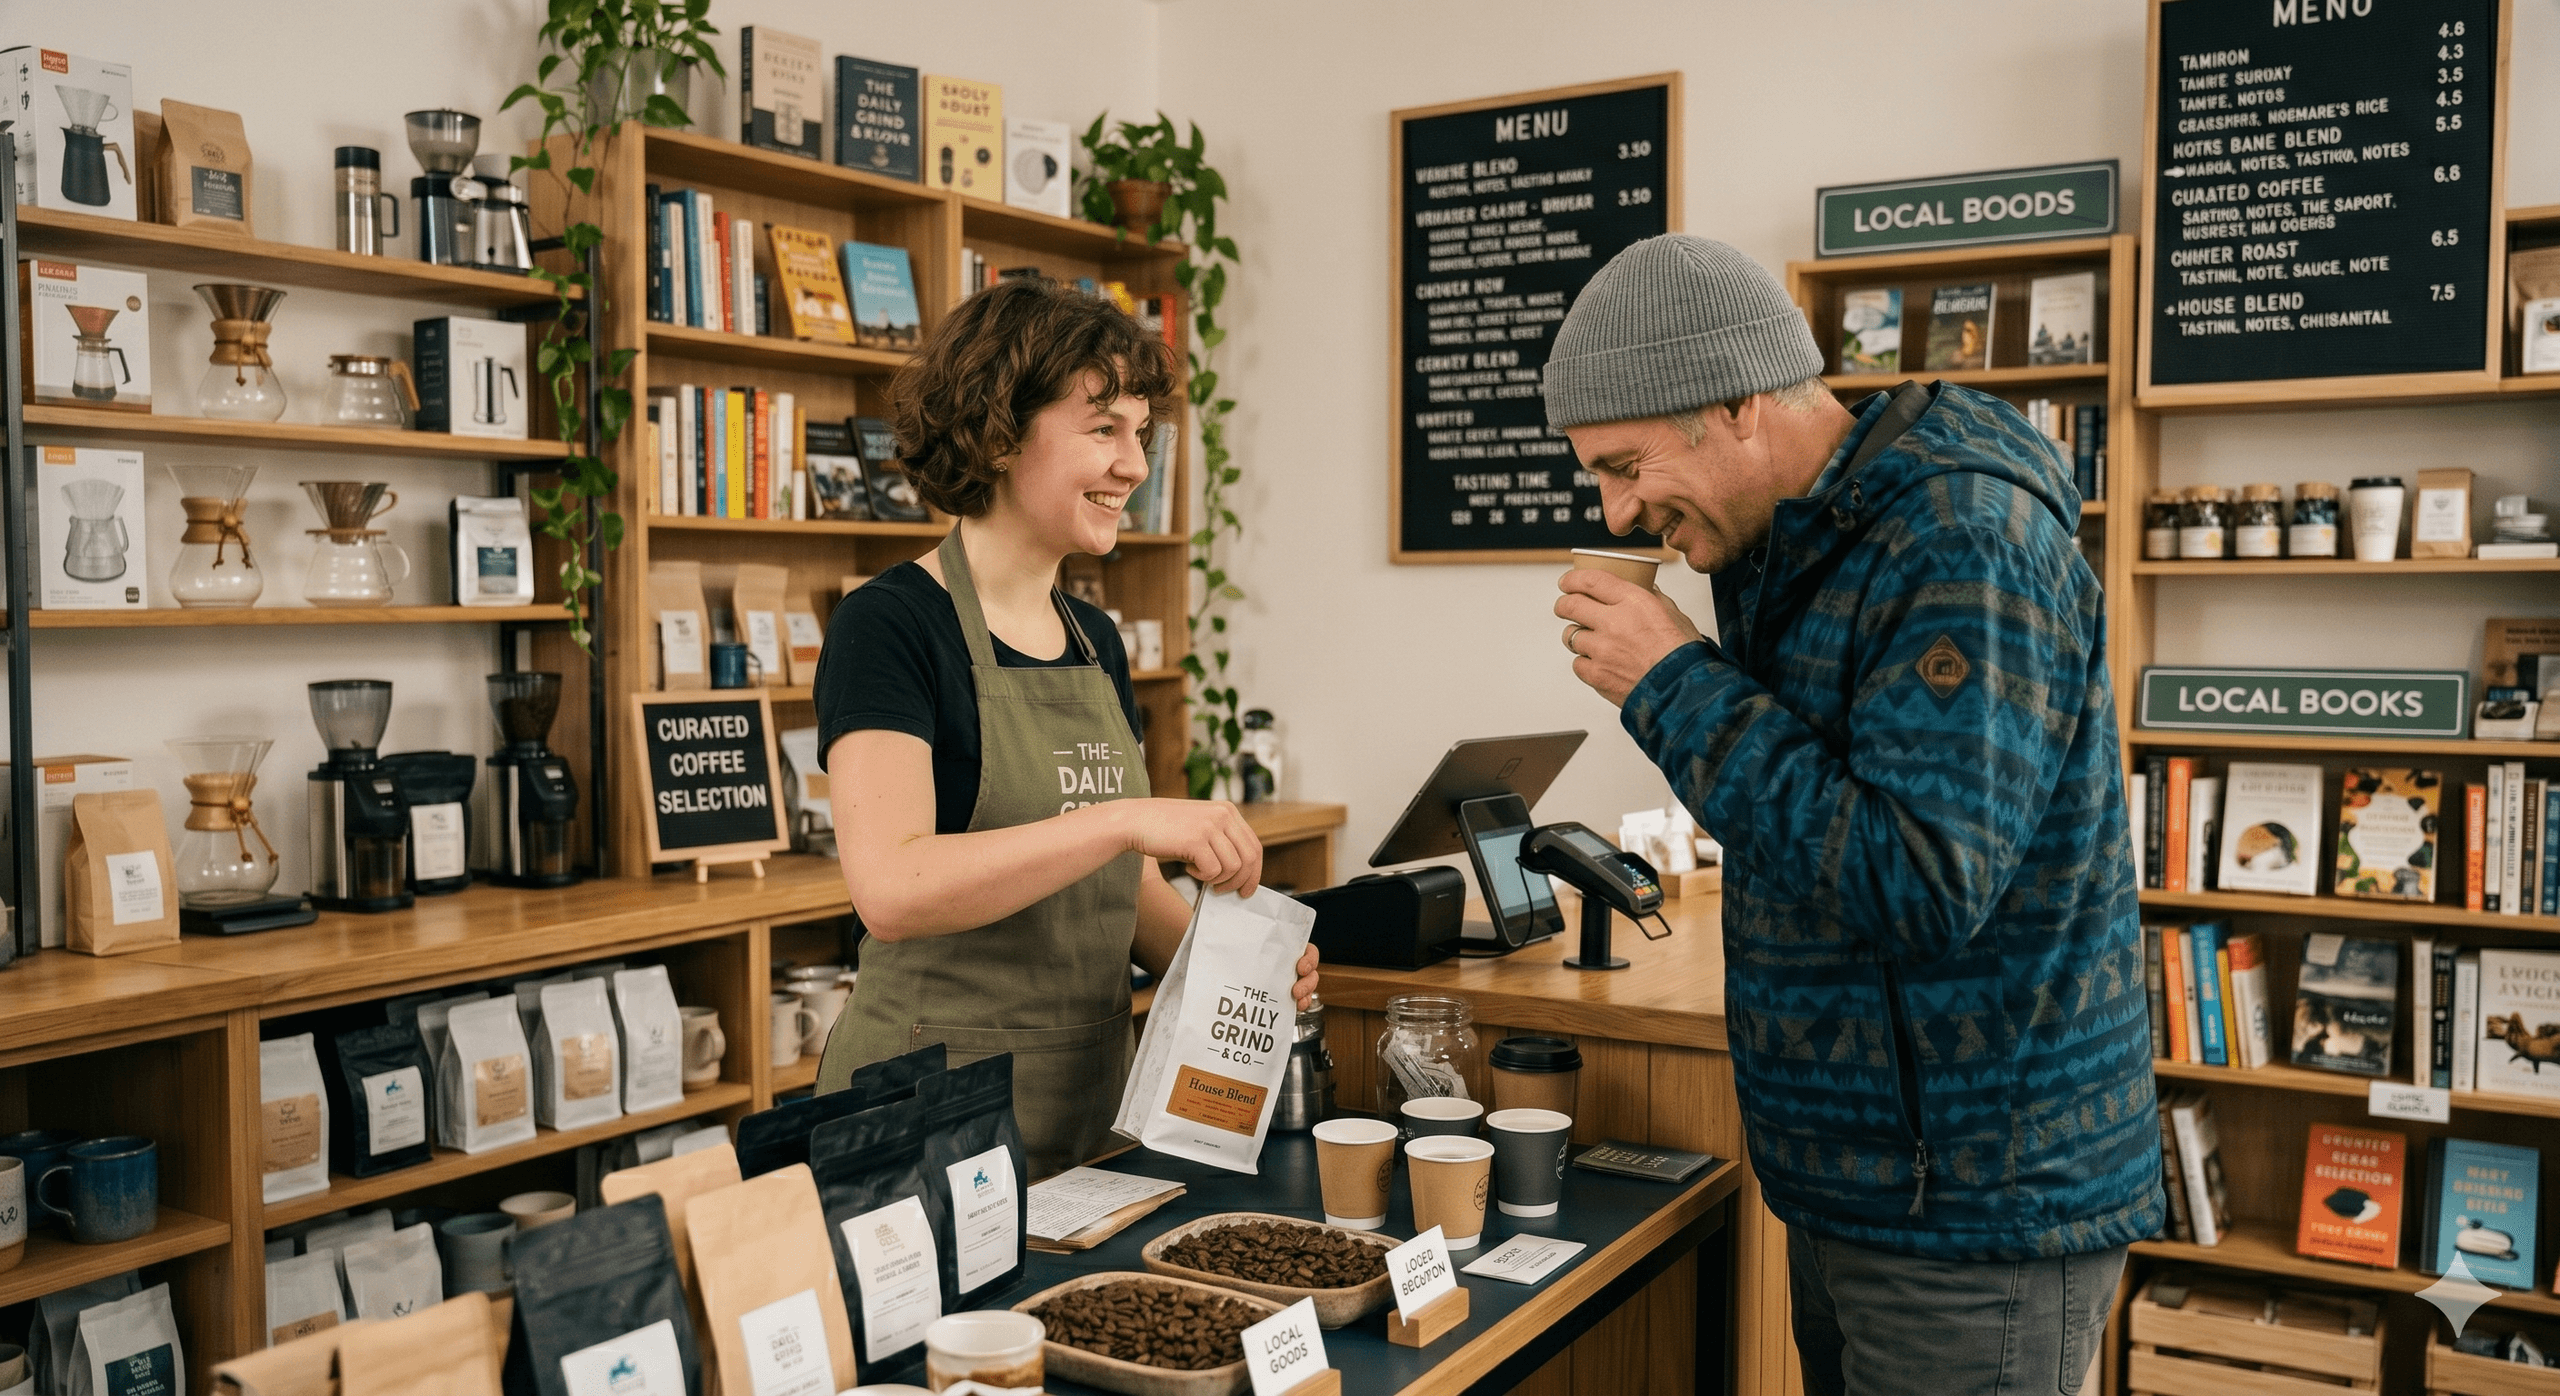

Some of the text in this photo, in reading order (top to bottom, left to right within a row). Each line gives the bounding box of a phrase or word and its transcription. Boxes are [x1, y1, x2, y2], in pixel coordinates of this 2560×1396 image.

[2437, 43, 2464, 61] 4.3
[2437, 66, 2464, 84] 3.5
[865, 78, 895, 97] THE
[2435, 89, 2463, 108] 4.5
[857, 93, 903, 112] DAILY
[2355, 97, 2389, 115] RICE
[1495, 108, 1568, 143] MENU
[2435, 114, 2462, 133] 5.5
[2230, 132, 2277, 154] BANE
[2284, 126, 2342, 148] BLEND
[2362, 141, 2410, 161] NOTES
[2257, 175, 2325, 199] COFFEE
[1854, 188, 2076, 233] LOCAL BOODS
[2431, 228, 2459, 247] 6.5
[2242, 239, 2300, 262] ROAST
[2349, 255, 2391, 273] NOTE
[2429, 282, 2456, 302] 7.5
[2178, 291, 2304, 317] HOUSE BLEND
[2178, 686, 2425, 719] LOCAL BOOKS
[657, 715, 750, 742] CURATED
[1076, 742, 1110, 760] THE
[669, 750, 746, 777] COFFEE
[1057, 766, 1124, 794] DAILY
[657, 783, 768, 815] SELECTION
[1243, 985, 1269, 1003] THE
[1217, 996, 1279, 1030] DAILY
[1211, 1020, 1274, 1054] GRIND
[1221, 1047, 1252, 1066] & CO.
[1188, 1077, 1258, 1105] House Blend
[1264, 1324, 1303, 1355] LOCAL
[1270, 1342, 1308, 1374] GOODS
